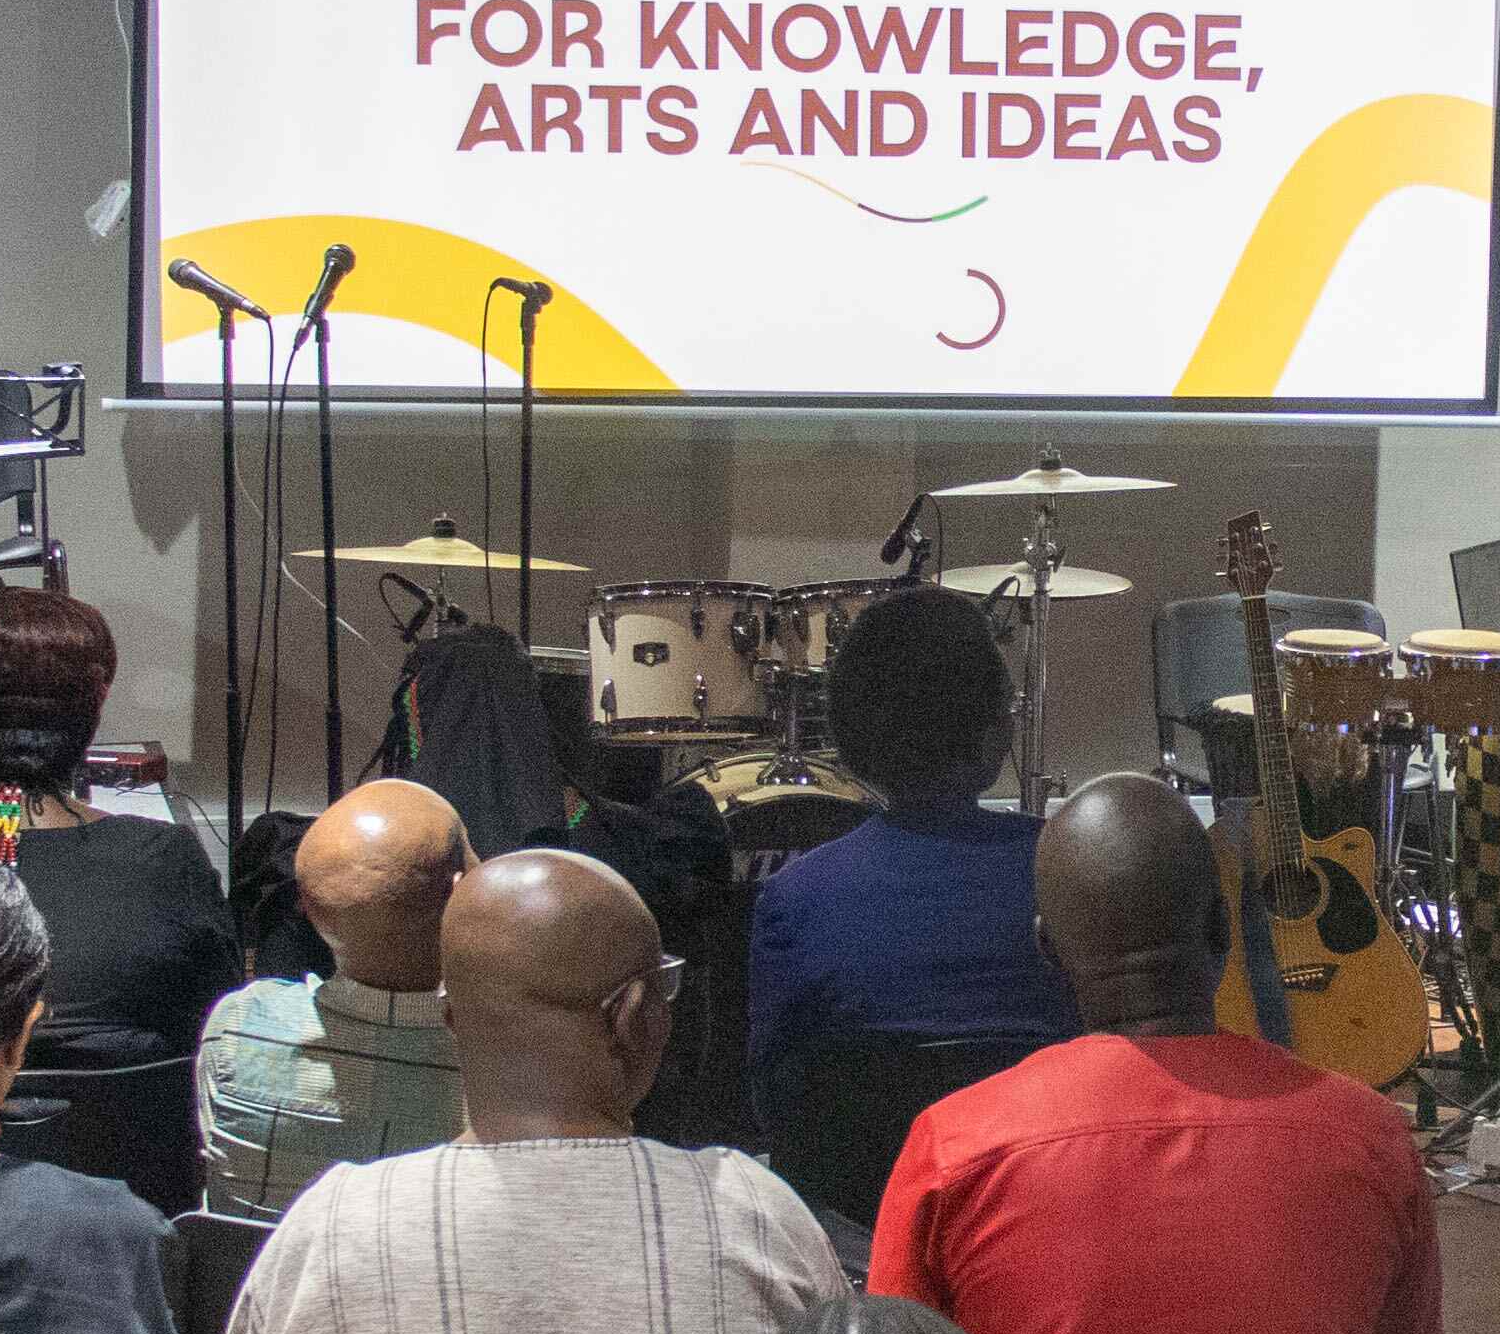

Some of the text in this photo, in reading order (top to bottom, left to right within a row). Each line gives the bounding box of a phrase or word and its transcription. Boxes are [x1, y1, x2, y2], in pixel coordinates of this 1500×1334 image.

[640, 1, 1263, 92] KNOWLEDGE,
[457, 84, 1221, 163] ARTS AND IDEAS
